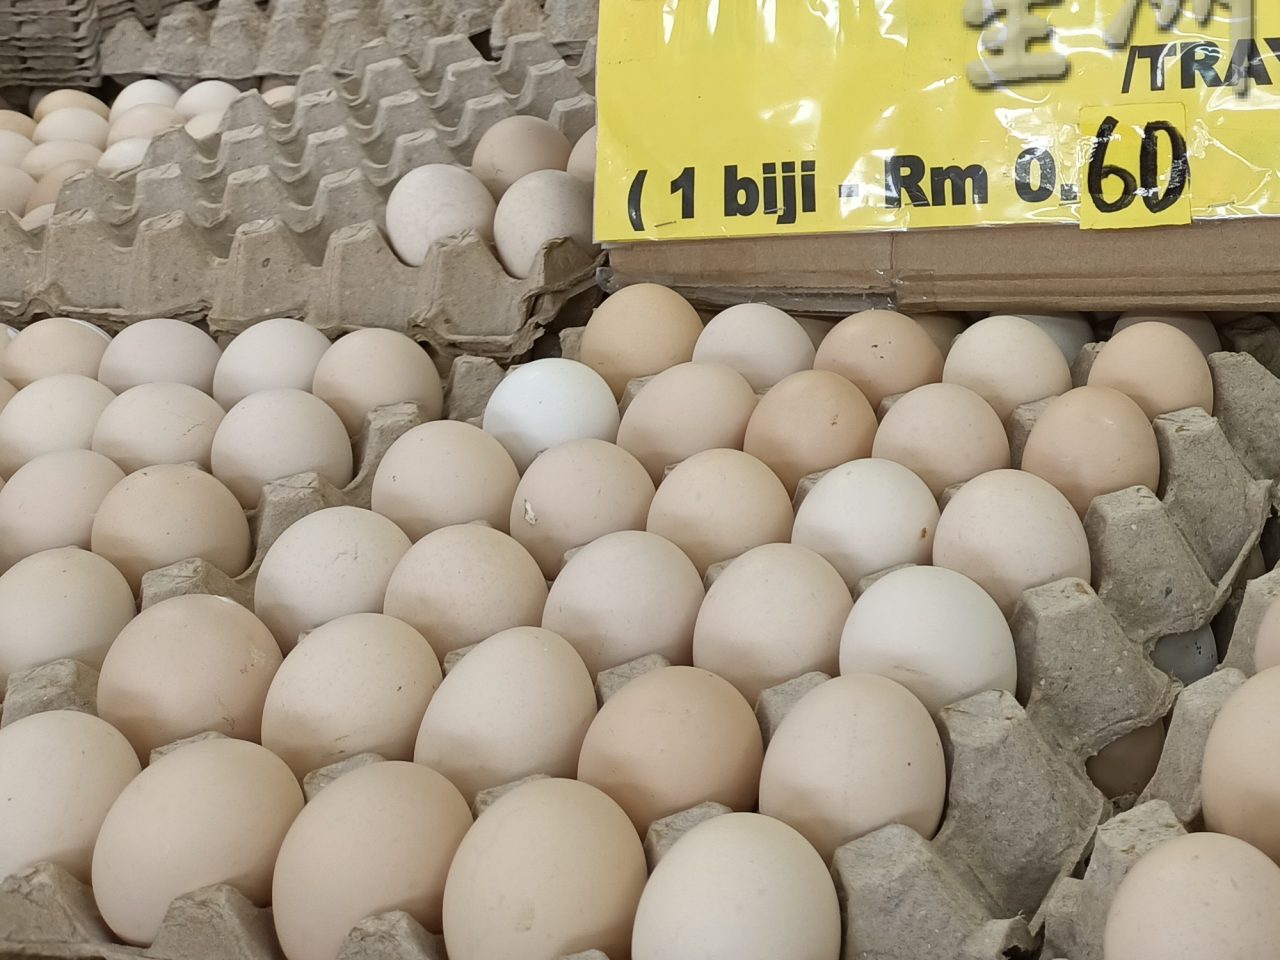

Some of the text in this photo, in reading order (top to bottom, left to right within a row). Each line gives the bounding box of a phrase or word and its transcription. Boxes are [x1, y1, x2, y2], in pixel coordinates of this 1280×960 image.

[670, 166, 696, 219] 1
[723, 160, 817, 224] biji
[884, 154, 989, 209] Rm
